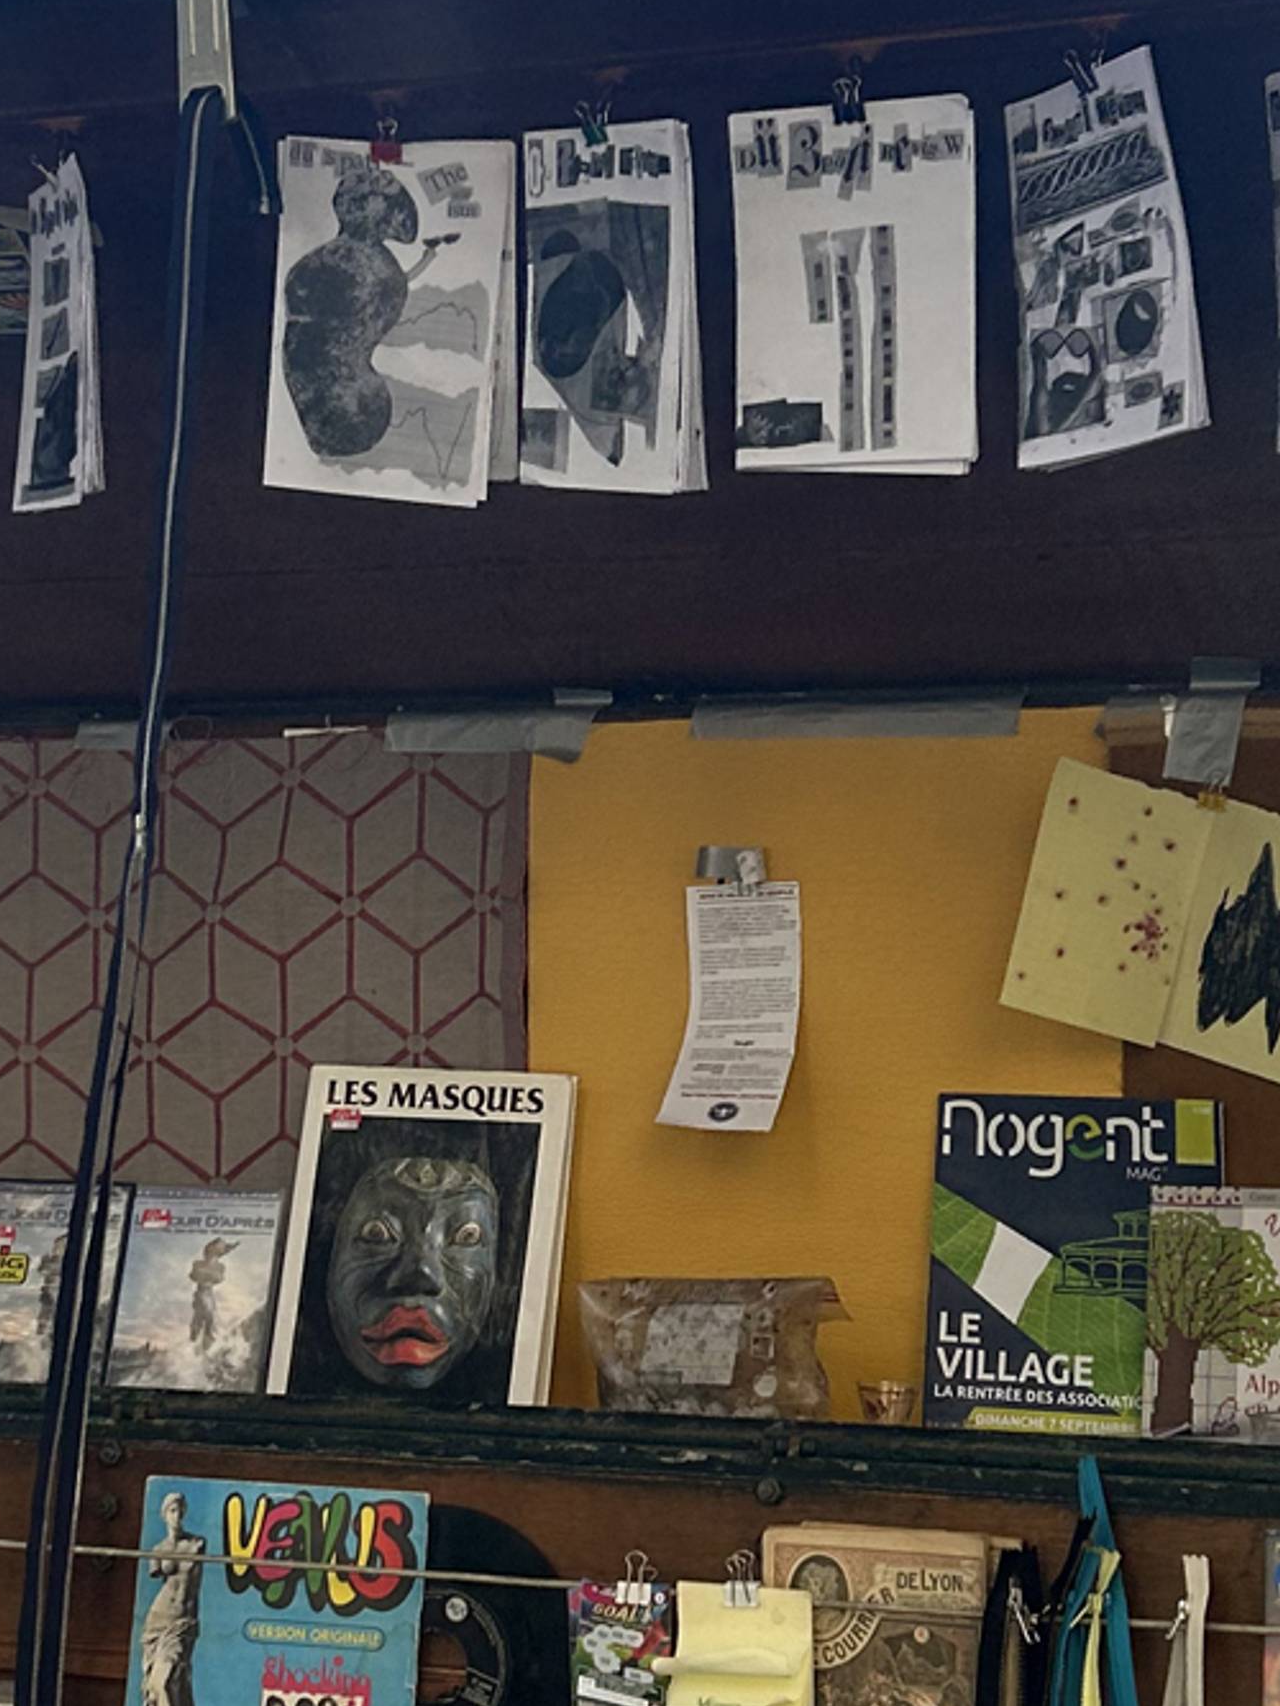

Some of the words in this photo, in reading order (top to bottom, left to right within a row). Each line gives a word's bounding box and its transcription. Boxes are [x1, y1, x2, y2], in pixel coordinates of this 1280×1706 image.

[326, 1079, 378, 1106] LES
[387, 1082, 544, 1117] MASQUES
[939, 1311, 981, 1345] LE
[936, 1347, 1094, 1387] VILLAGE
[934, 1384, 954, 1398] LA
[957, 1385, 1021, 1403] RENTRÉE
[1026, 1392, 1054, 1405] DES
[1057, 1393, 1143, 1411] ASSOCIATIO
[974, 1412, 1046, 1429] DIMANCHE
[224, 1491, 418, 1617] VENUS
[248, 1626, 306, 1641] VERSION
[311, 1630, 380, 1645] ORIGINALE
